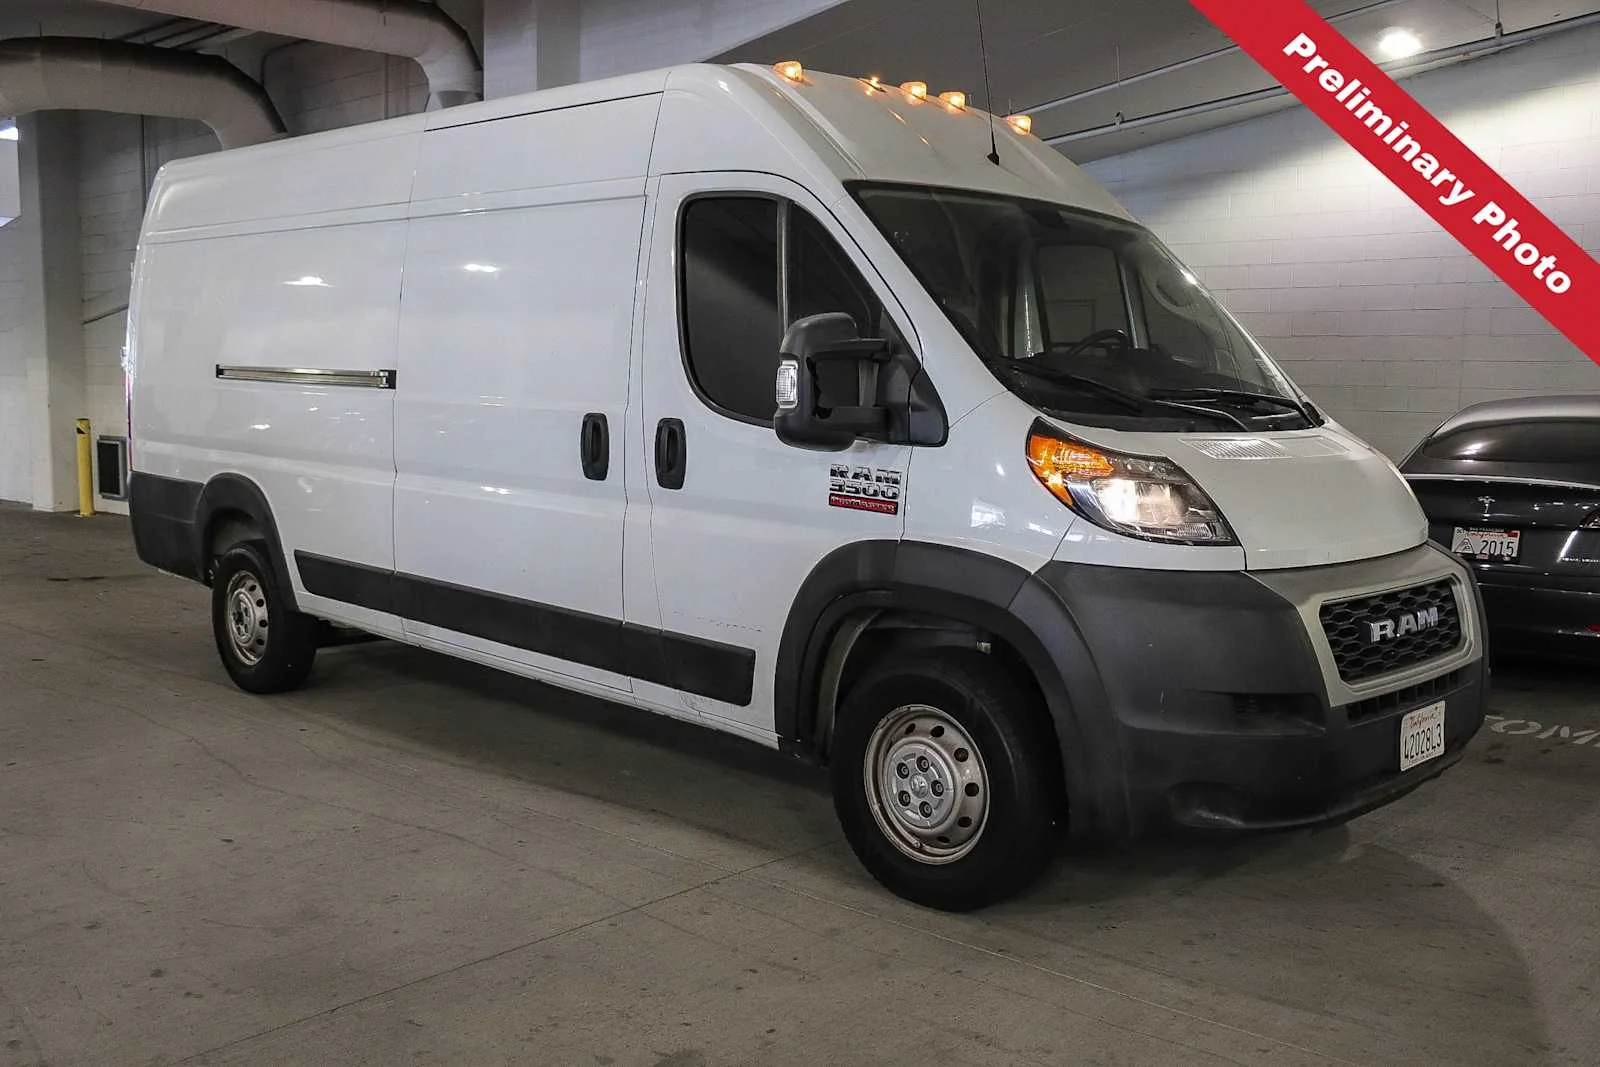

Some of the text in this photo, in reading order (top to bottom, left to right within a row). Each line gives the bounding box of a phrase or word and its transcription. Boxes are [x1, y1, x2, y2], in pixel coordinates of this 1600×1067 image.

[829, 463, 902, 485] RAM
[829, 478, 900, 499] 3500
[1480, 540, 1515, 556] 2015
[1370, 606, 1439, 643] RAM
